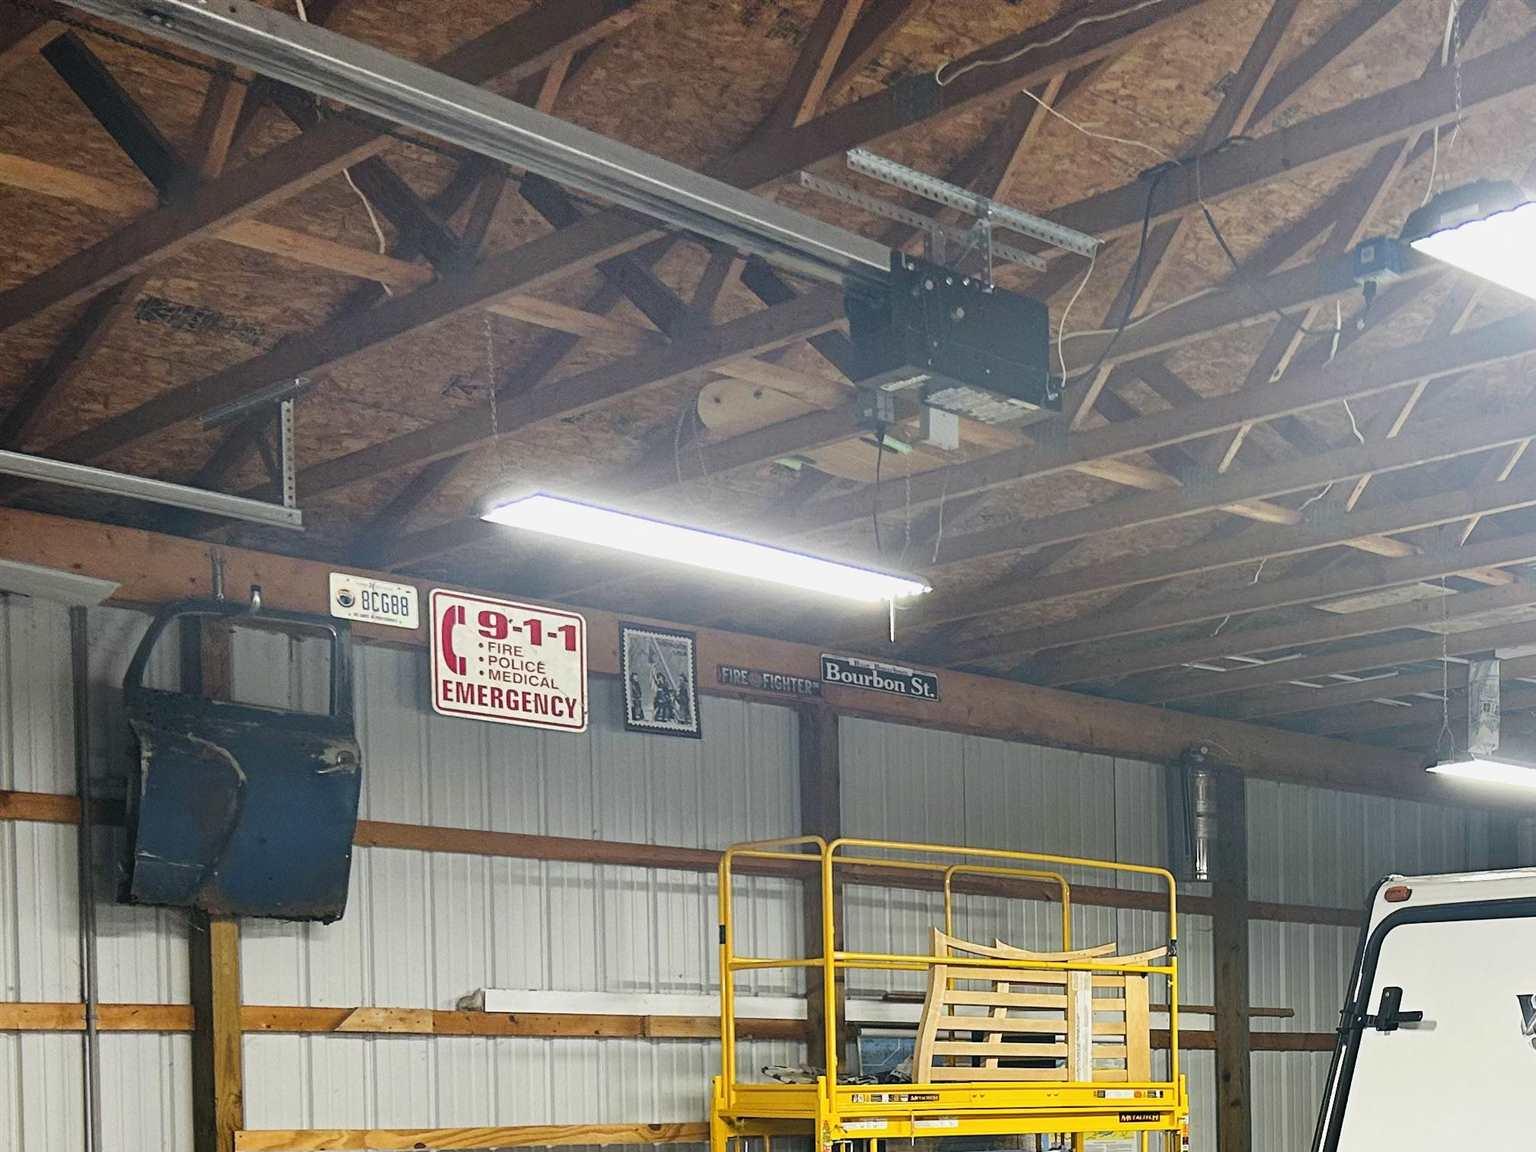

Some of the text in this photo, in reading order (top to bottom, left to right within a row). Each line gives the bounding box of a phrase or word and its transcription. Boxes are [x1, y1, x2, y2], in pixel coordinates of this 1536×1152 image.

[478, 610, 577, 652] 9-1-1
[488, 642, 525, 657] FIRE
[488, 655, 546, 675] POLICE
[488, 669, 560, 690] MEDICAL
[826, 661, 906, 694] Bourbon
[911, 677, 936, 698] St.
[720, 666, 813, 696] FIRE FIGHTER
[442, 679, 577, 719] EMERGENCY
